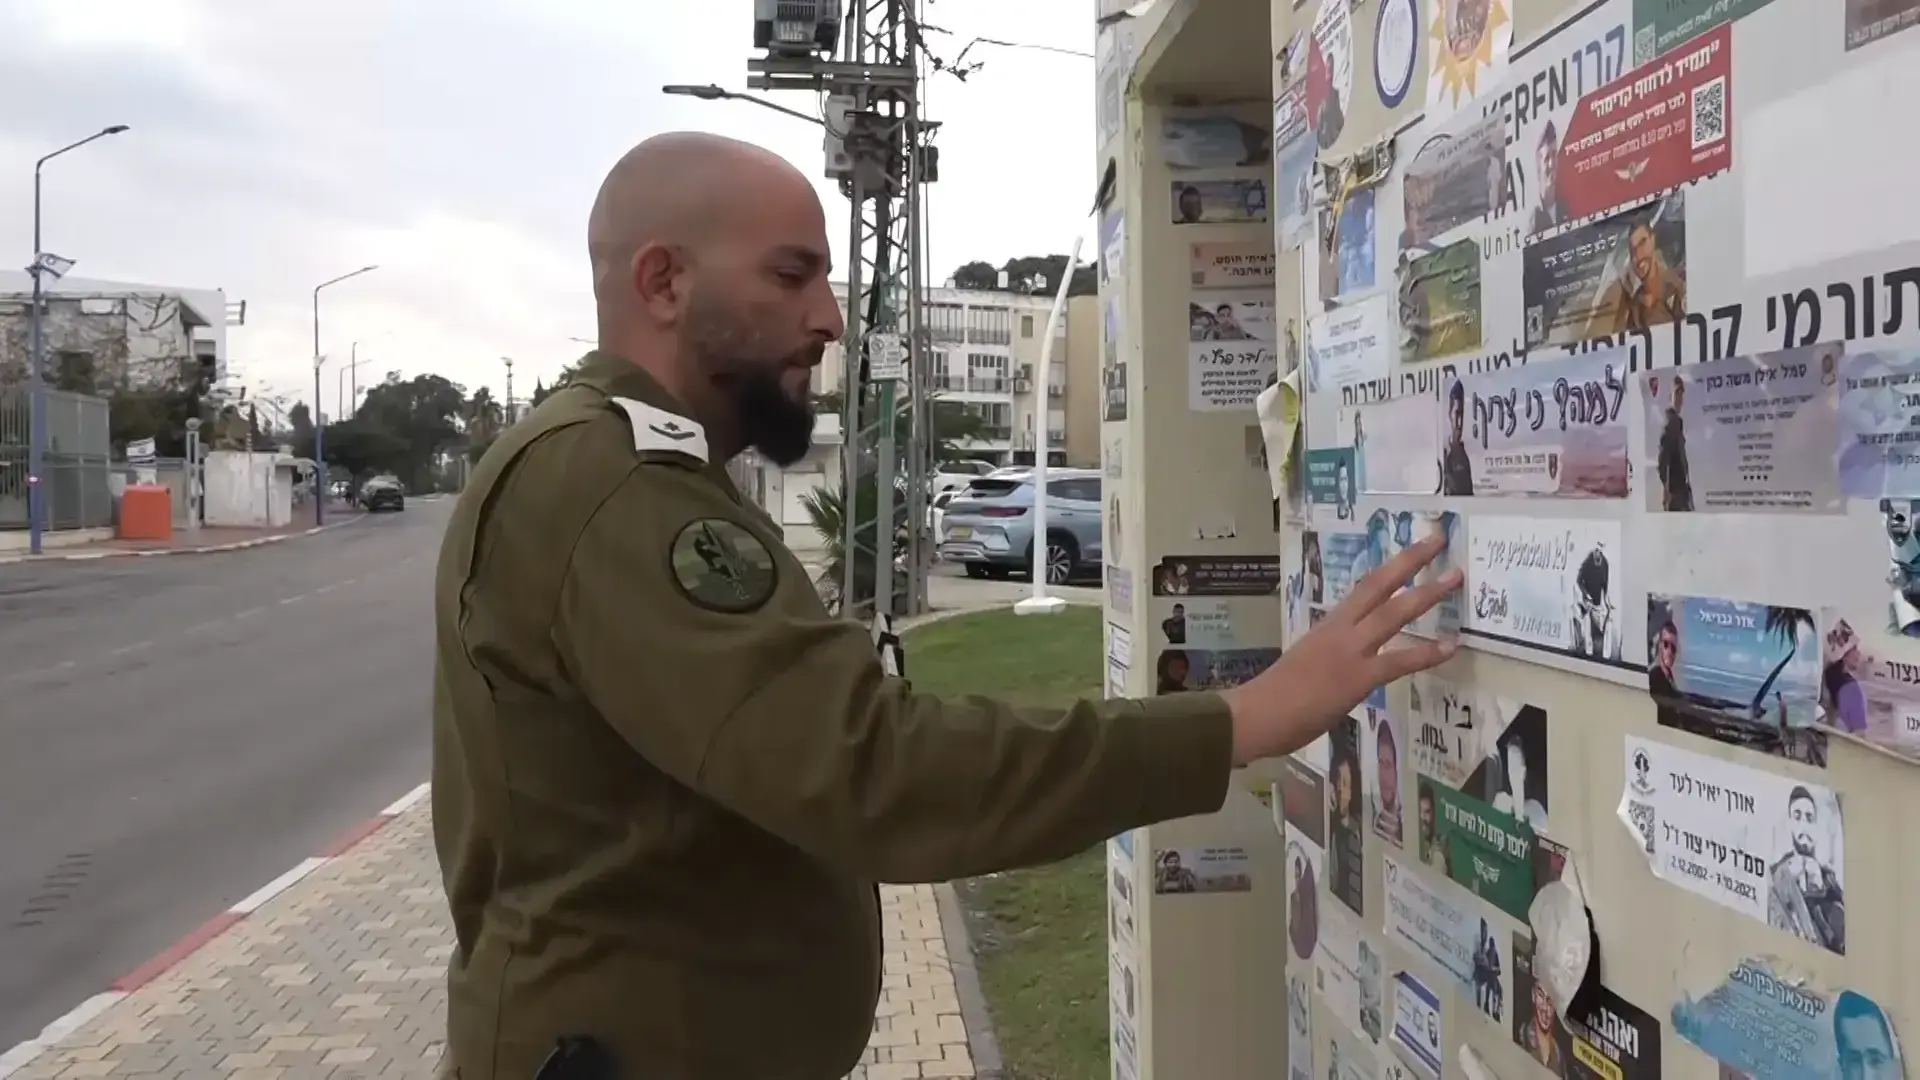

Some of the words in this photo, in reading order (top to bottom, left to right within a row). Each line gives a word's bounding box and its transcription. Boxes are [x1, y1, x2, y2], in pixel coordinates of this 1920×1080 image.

[1634, 61, 1674, 99] לדחוף
[1766, 266, 1920, 349] תורמי
[1669, 771, 1693, 794] לעד
[1695, 779, 1721, 802] יאיר
[1723, 791, 1755, 815] אורך
[1682, 830, 1703, 854] צור
[1705, 837, 1728, 863] עדי
